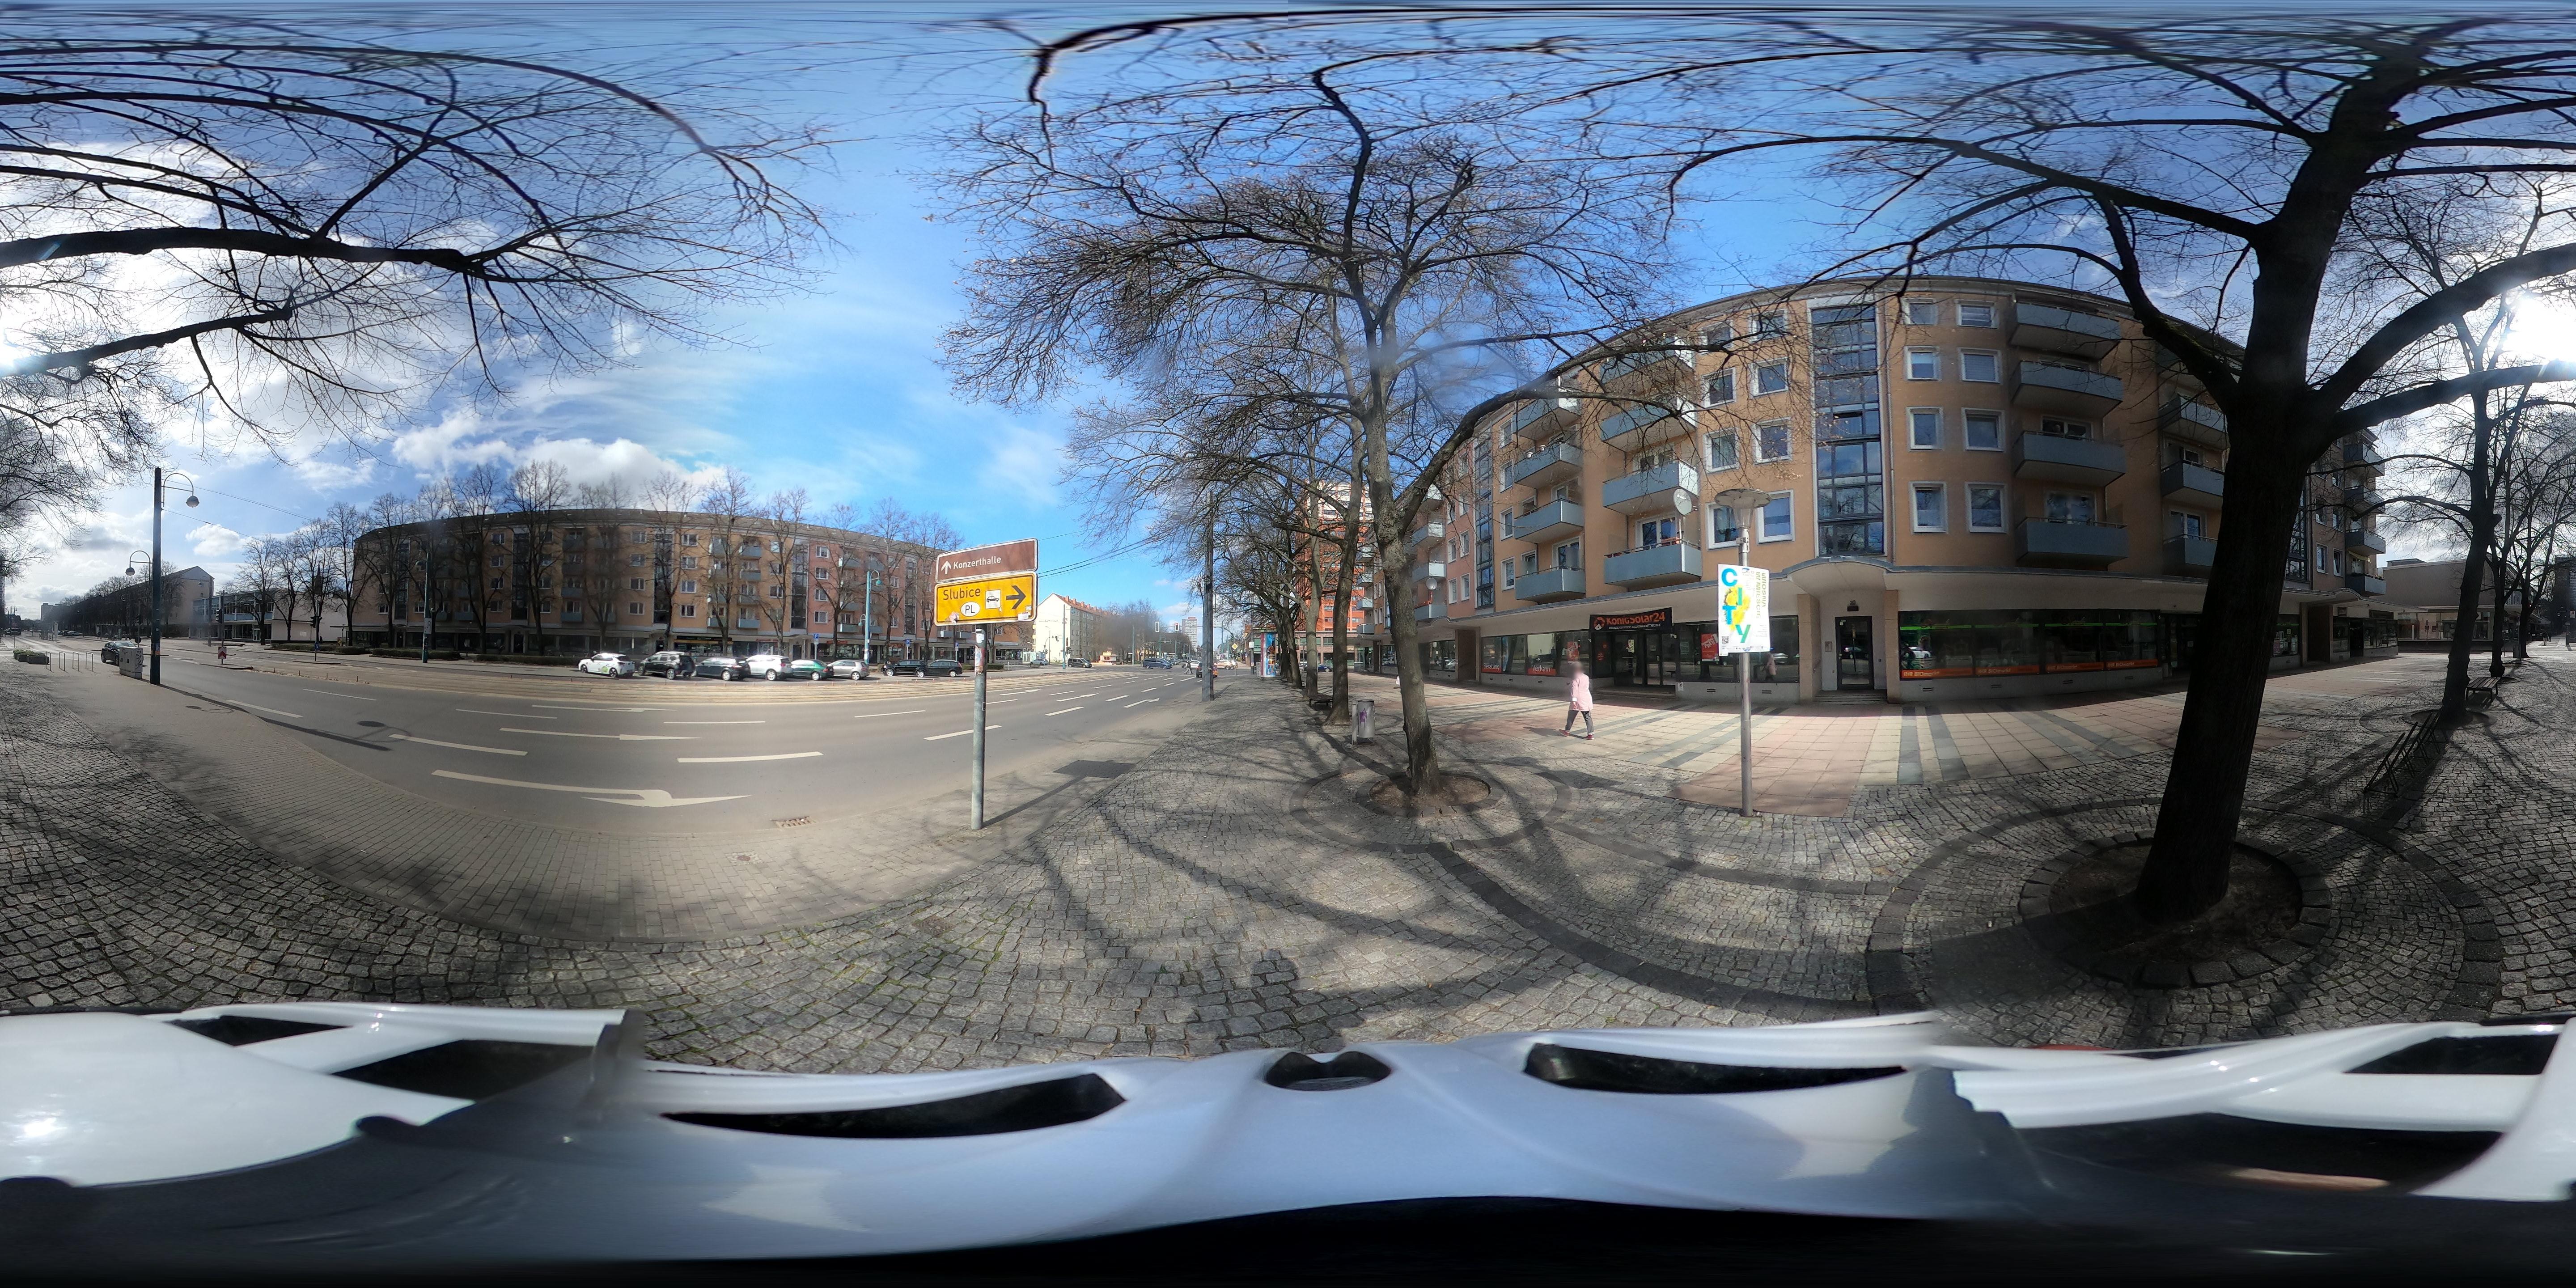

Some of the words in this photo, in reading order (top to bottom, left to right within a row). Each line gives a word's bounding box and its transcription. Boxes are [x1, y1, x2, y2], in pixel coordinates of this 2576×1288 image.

[953, 556, 1001, 569] Konzerthalle
[943, 587, 981, 600] Slubice
[965, 605, 975, 614] PL
[1483, 663, 1500, 671] Beratung
